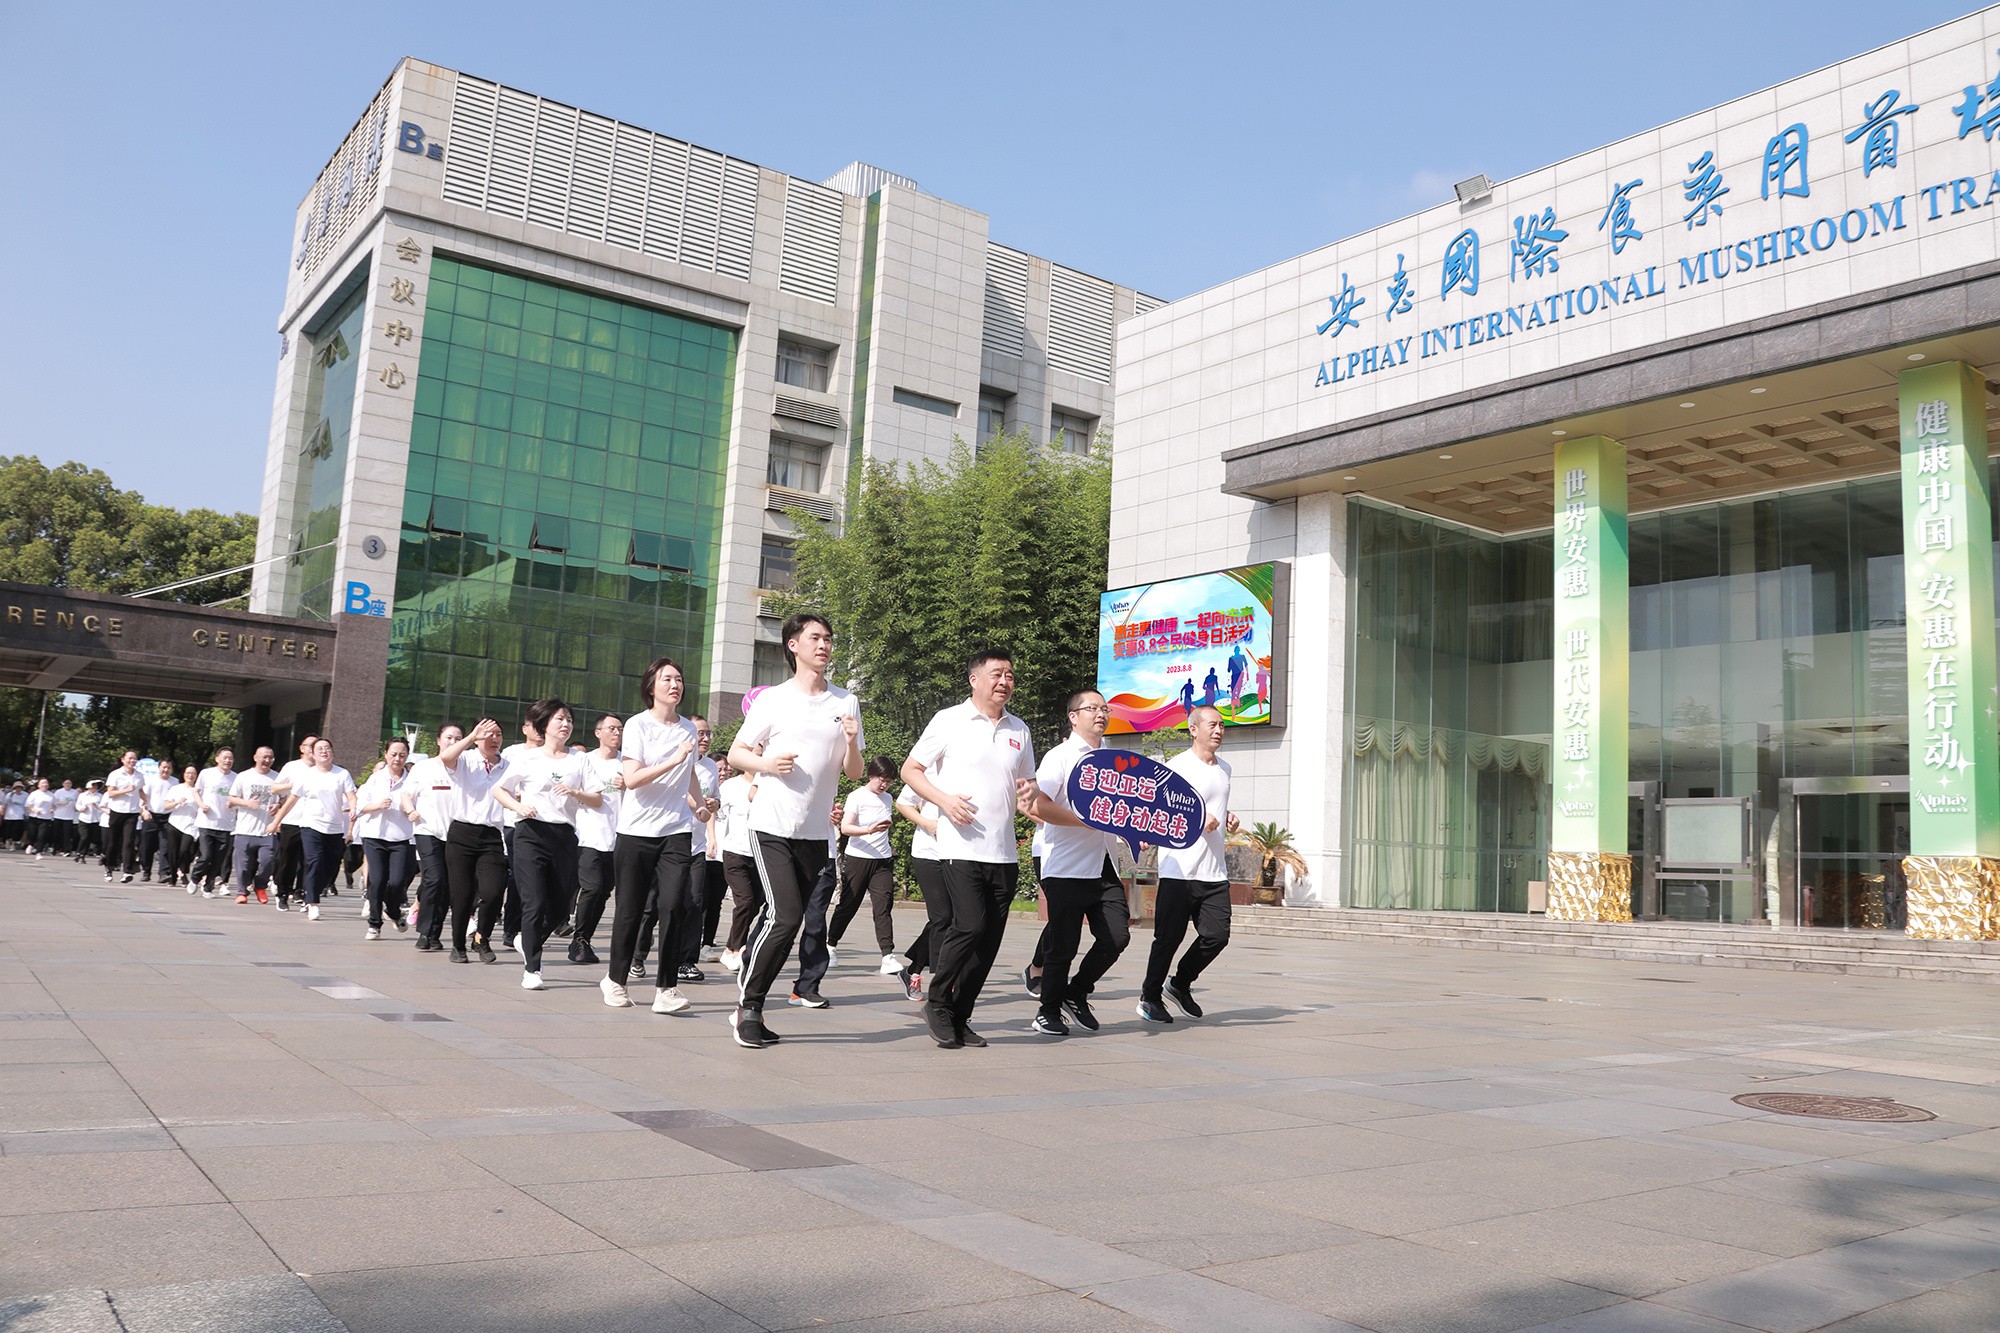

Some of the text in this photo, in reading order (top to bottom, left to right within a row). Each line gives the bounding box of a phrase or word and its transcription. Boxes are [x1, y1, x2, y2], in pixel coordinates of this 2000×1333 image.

[399, 120, 445, 163] B座
[379, 236, 422, 389] 会议中心
[1315, 336, 1412, 388] ALPHAY
[1421, 266, 1666, 359] INTERNATIONAL
[1679, 195, 1908, 290] MUSHROOM
[1915, 400, 1953, 555] 健康中国
[368, 540, 378, 554] 3
[345, 581, 387, 617] B座
[1563, 468, 1590, 761] 世界安惠 世代安惠
[7, 605, 318, 660] RENCE CENTER
[1166, 664, 1192, 674] 2023.8.8
[1920, 573, 1960, 771] 安惠在行动
[1079, 764, 1157, 802] 喜迎亚运
[1162, 784, 1197, 807] Alphay
[1915, 790, 1968, 812] Alphay
[1089, 796, 1189, 839] 健身动起来
